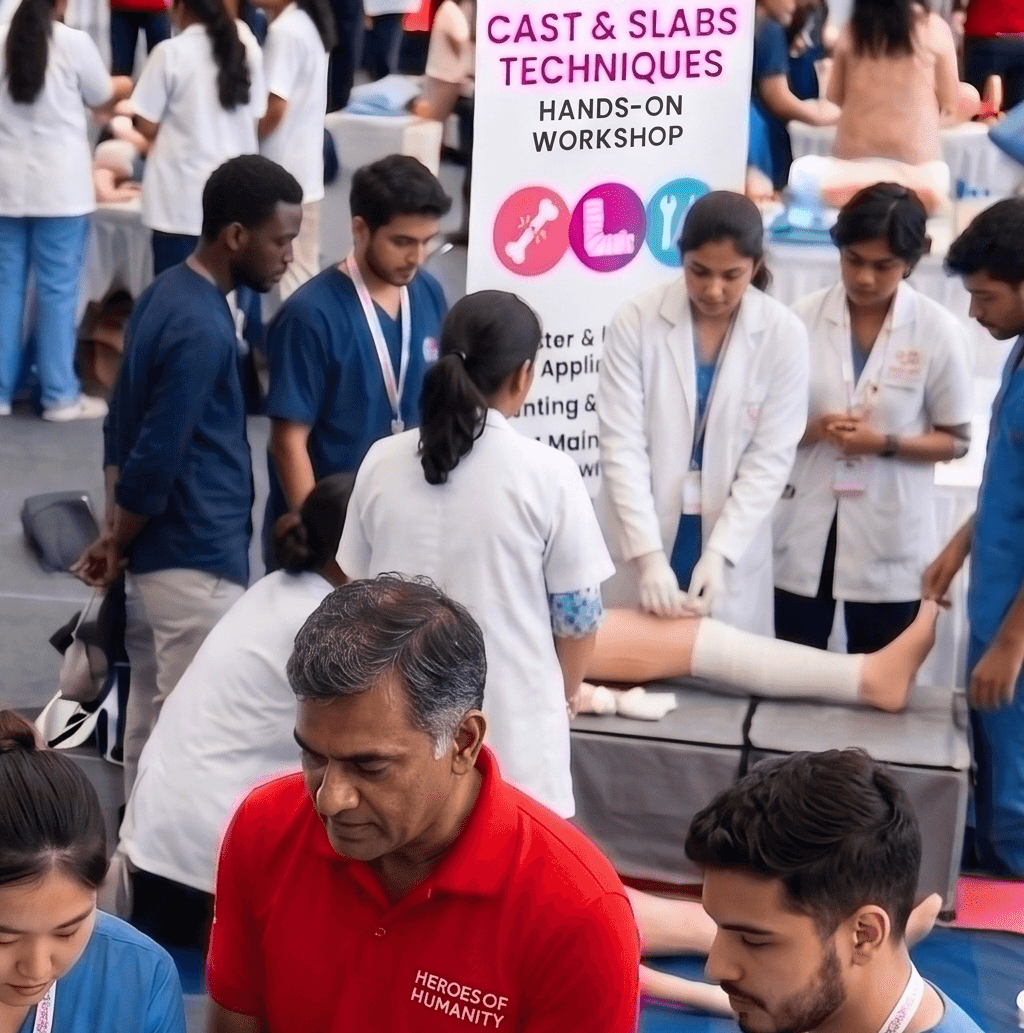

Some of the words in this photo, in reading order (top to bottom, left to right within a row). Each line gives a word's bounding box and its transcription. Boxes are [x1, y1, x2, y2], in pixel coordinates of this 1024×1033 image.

[487, 12, 583, 44] CAST
[591, 12, 616, 40] &
[629, 7, 738, 40] SLABS
[500, 49, 723, 86] TECHNIQUES
[539, 94, 683, 122] HANDS-ON
[532, 125, 684, 153] WORKSHOP
[581, 329, 594, 346] &
[584, 394, 596, 412] &
[415, 969, 482, 1004] HEROES
[410, 987, 505, 1029] HUMANITY
